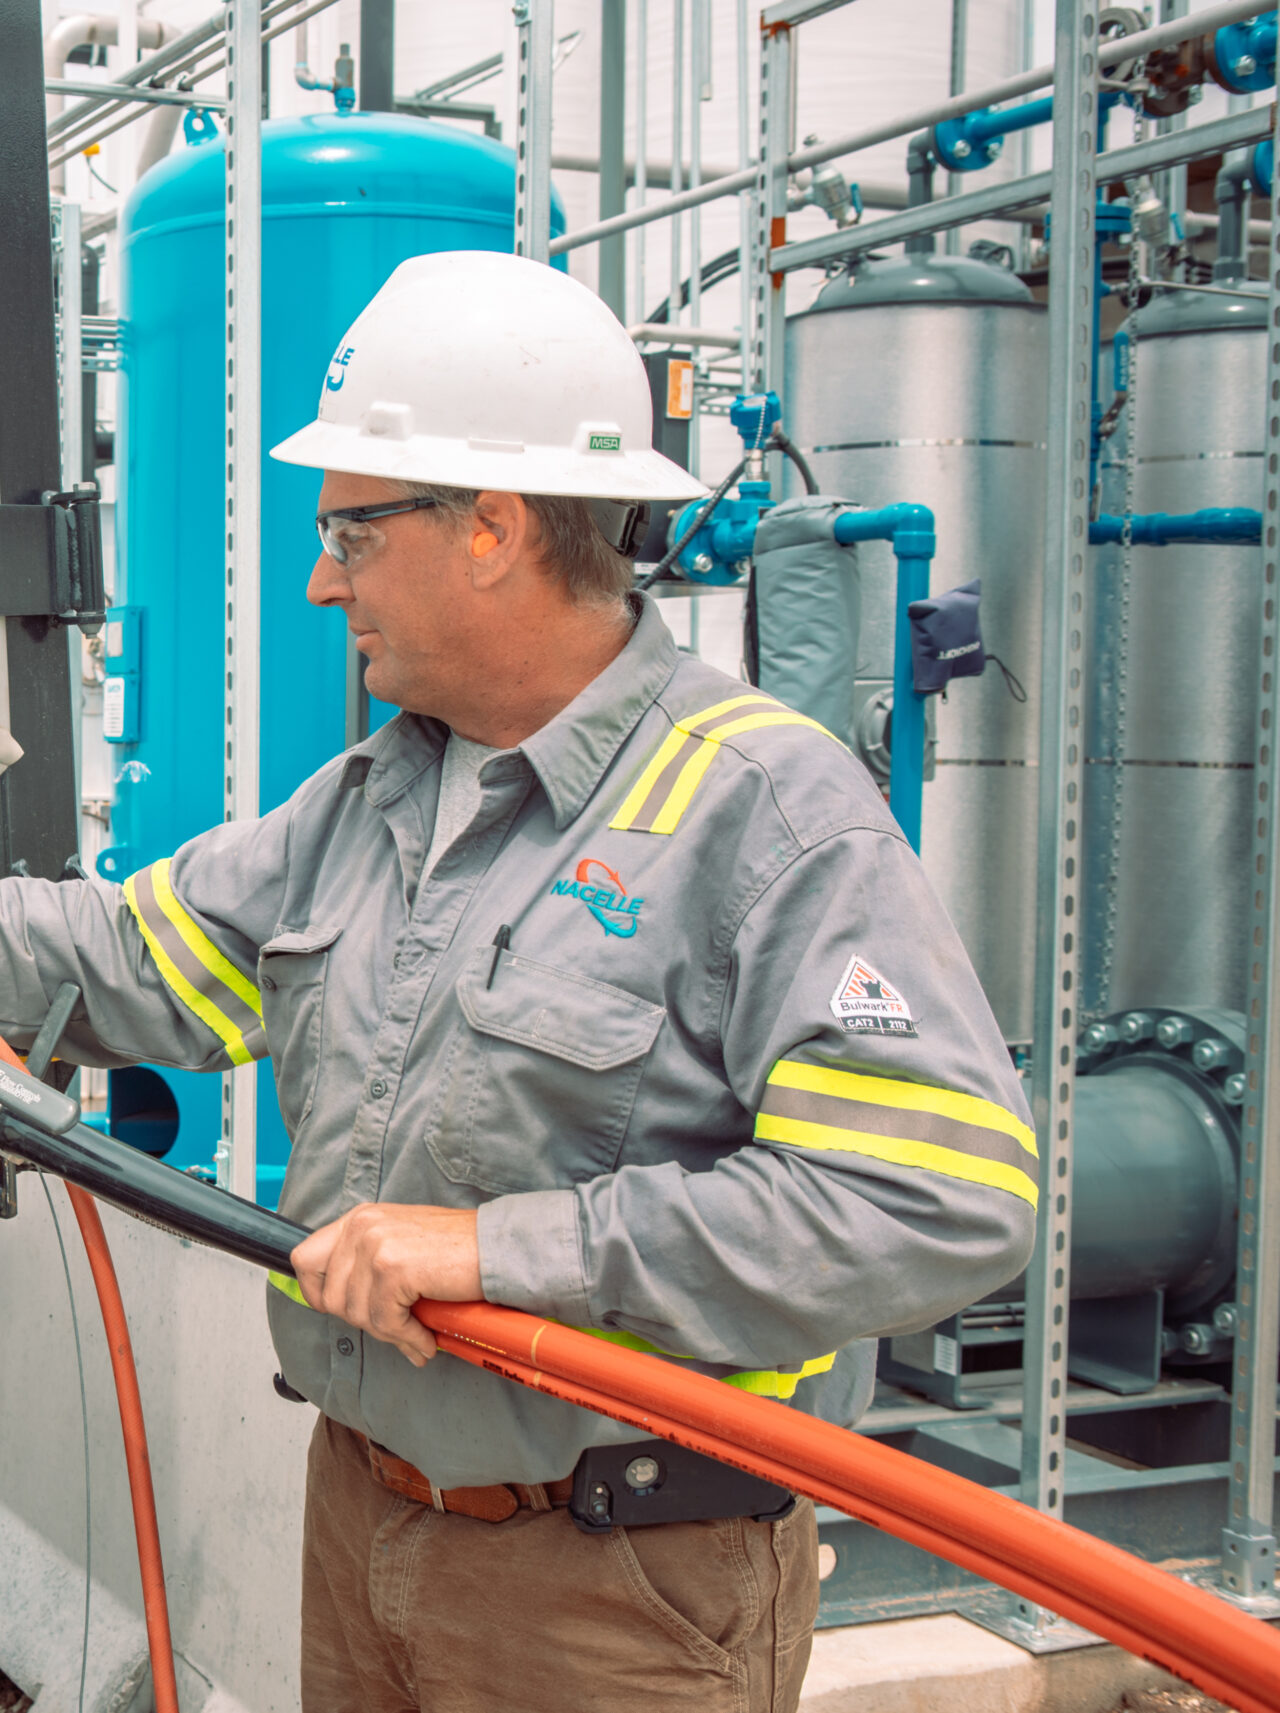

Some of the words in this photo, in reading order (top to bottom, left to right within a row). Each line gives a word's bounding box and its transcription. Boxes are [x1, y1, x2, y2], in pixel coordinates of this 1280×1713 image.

[592, 438, 618, 449] MSA
[551, 880, 644, 915] NACELLE
[889, 1003, 904, 1013] FR
[888, 1020, 907, 1030] 2112
